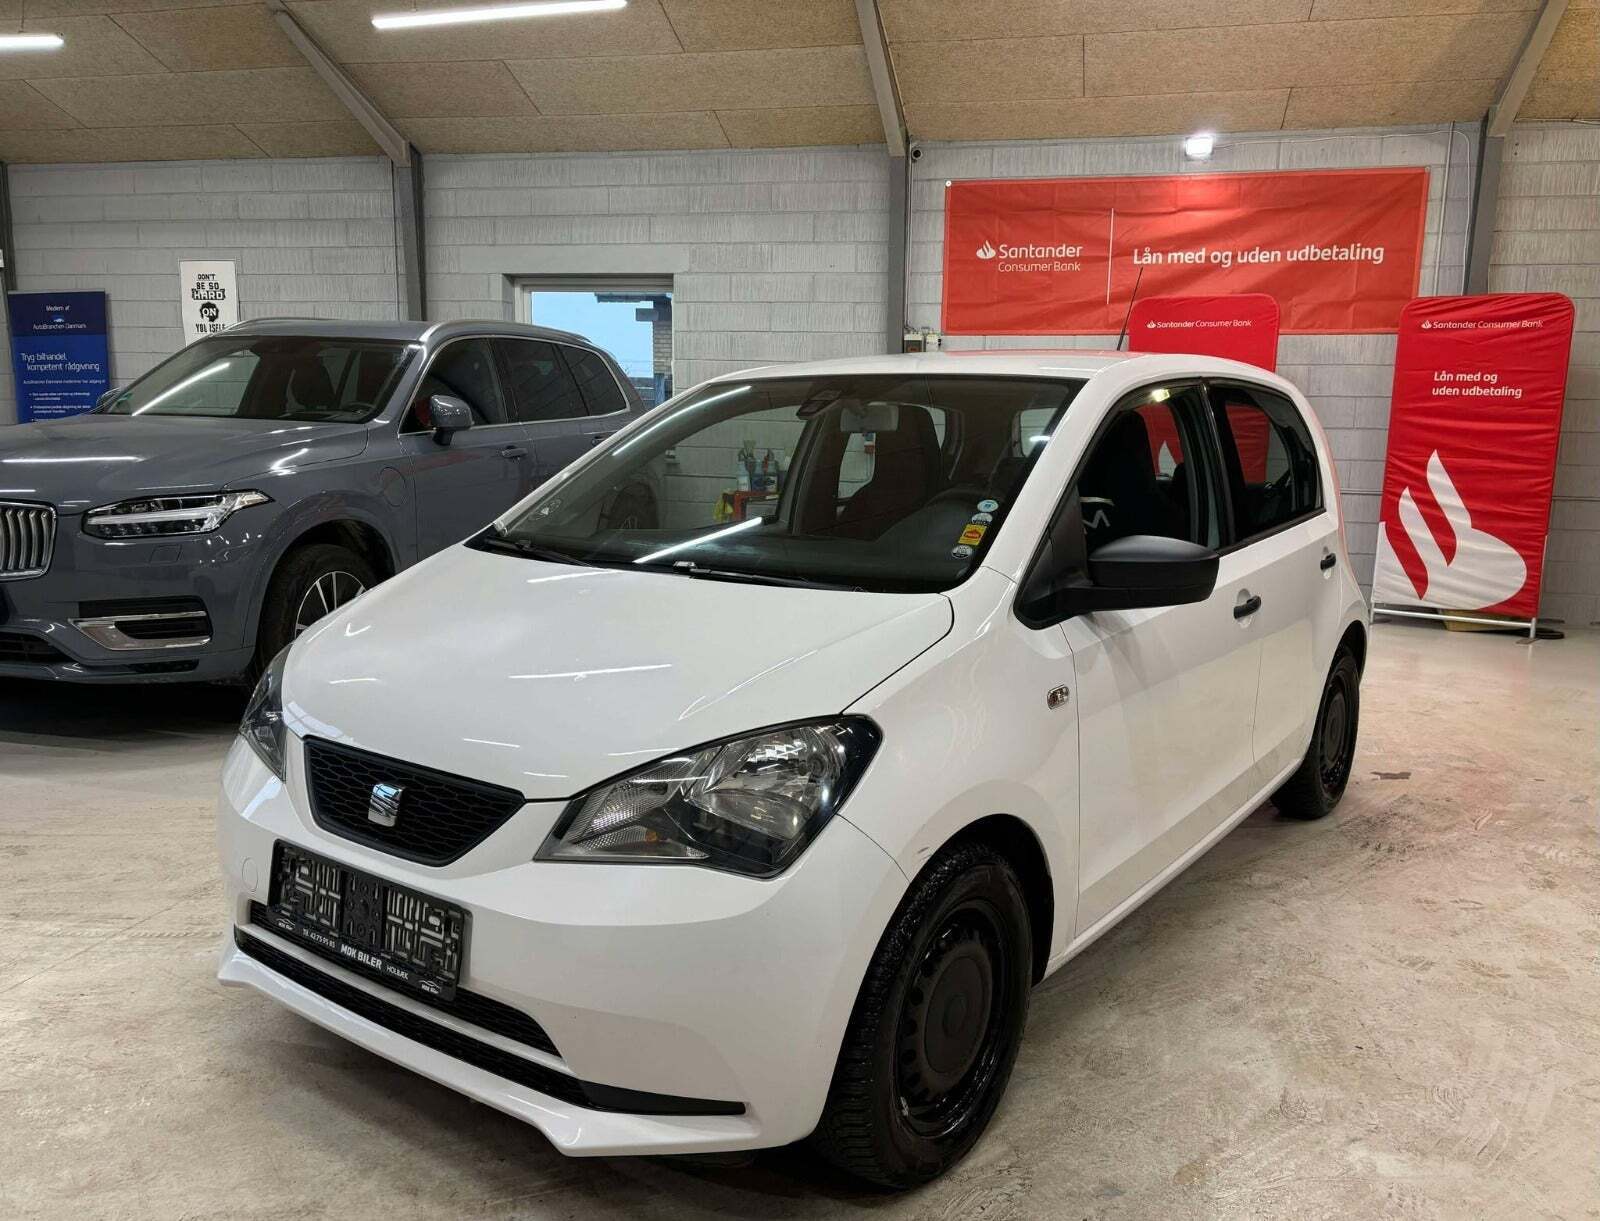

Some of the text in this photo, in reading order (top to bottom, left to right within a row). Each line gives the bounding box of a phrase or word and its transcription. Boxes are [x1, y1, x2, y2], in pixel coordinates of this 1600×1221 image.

[999, 244, 1083, 259] Santander
[1133, 243, 1385, 268] Lån med og uden udbetaling
[998, 261, 1081, 273] Consumer Bank
[197, 273, 216, 281] DON'T
[196, 281, 220, 290] BE SO
[194, 291, 224, 300] HARD
[202, 308, 217, 317] ON
[1156, 319, 1252, 329] Santander Consumer Bank
[1433, 319, 1544, 329] Santander Consumer Bank
[21, 352, 35, 363] Tryg
[27, 362, 100, 373] kompetent rådgivning
[1434, 370, 1498, 384] Lån med og
[1432, 386, 1522, 398] uden udbetaling
[341, 943, 382, 969] MDK BILER
